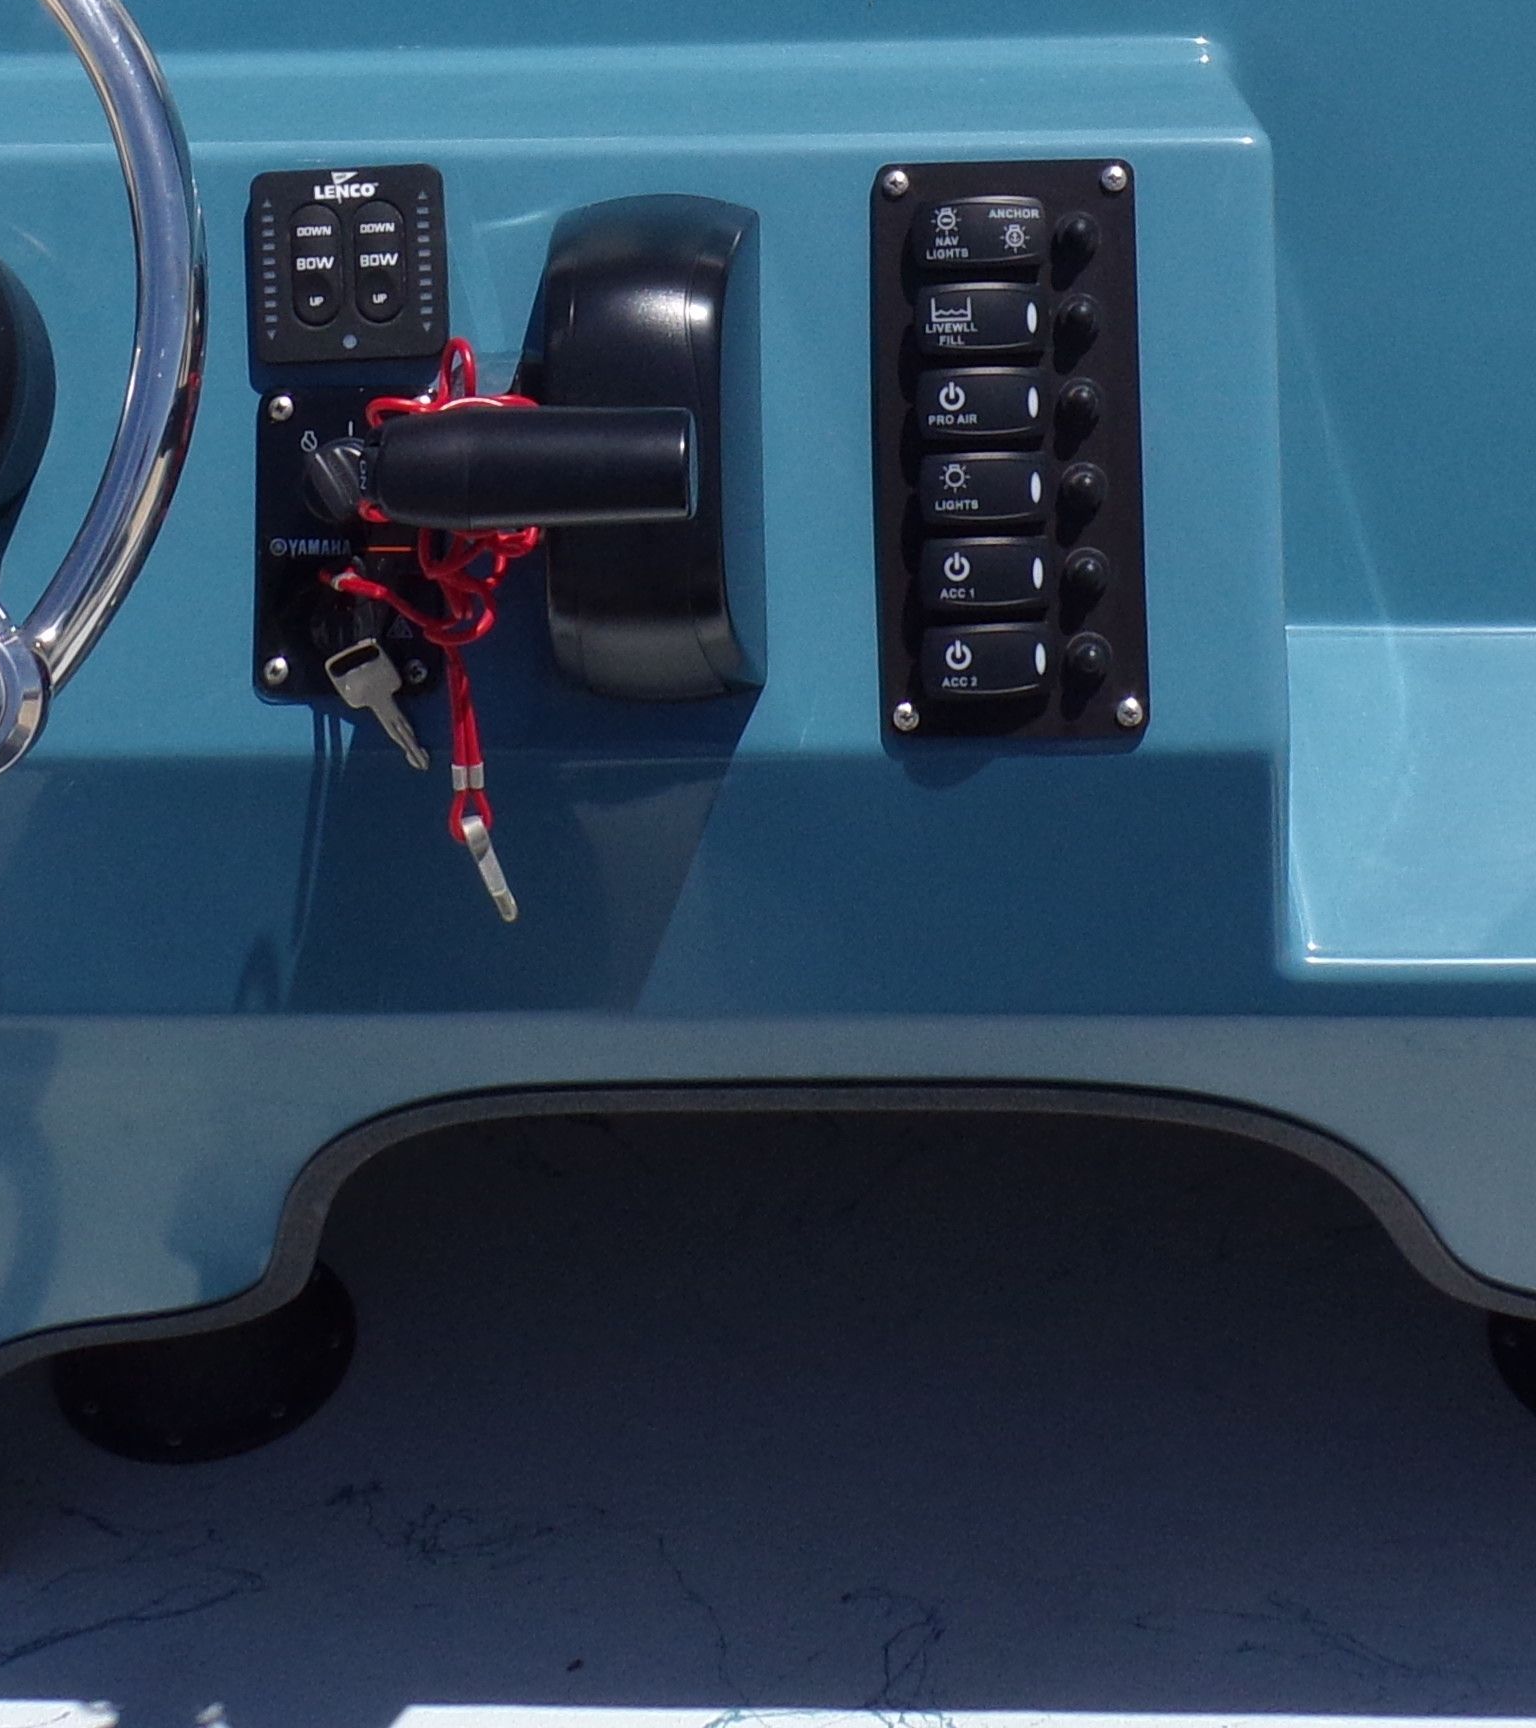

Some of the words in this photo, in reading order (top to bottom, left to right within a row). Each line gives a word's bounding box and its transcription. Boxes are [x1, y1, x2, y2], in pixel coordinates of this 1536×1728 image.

[314, 182, 376, 202] LENCO
[988, 208, 1040, 219] ANCHOR
[296, 225, 332, 238] DOWN
[359, 222, 395, 234] DOWN
[935, 235, 959, 247] NAV
[359, 252, 398, 268] BOW
[925, 247, 969, 260] LIGHTS
[296, 255, 335, 271] BOW
[309, 295, 325, 307] UP
[372, 292, 388, 304] UP
[925, 322, 978, 334] LIVEWLL
[939, 334, 965, 346] FILL
[928, 414, 955, 426] PRO
[957, 413, 978, 424] AIR
[934, 498, 979, 511] LIGHTS
[289, 537, 352, 557] YAMAHA
[940, 587, 966, 599] ACC
[967, 587, 975, 599] 1
[941, 676, 968, 688] ACC
[970, 675, 978, 687] 2
